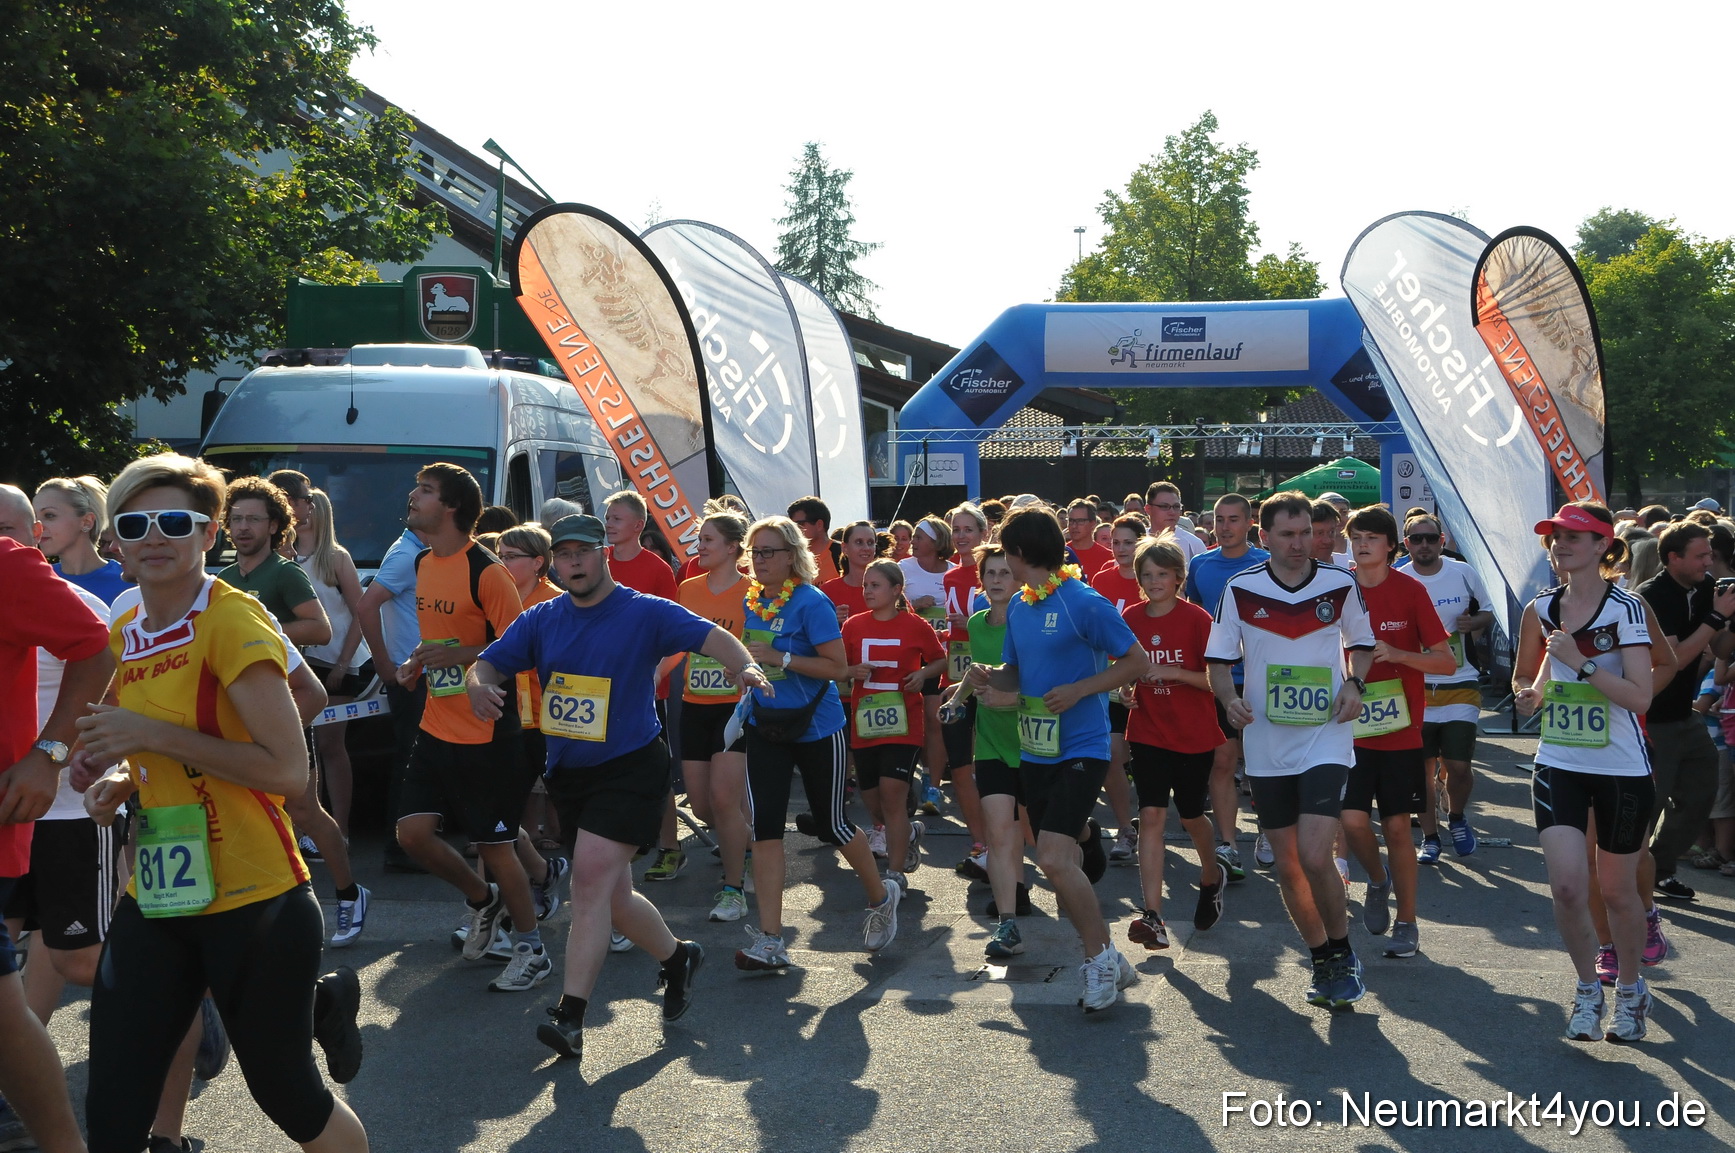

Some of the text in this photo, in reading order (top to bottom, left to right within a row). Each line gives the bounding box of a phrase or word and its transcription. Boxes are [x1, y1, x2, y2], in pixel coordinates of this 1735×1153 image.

[436, 326, 460, 336] 1628
[1171, 325, 1203, 333] Fischer
[1146, 342, 1243, 360] firmenlauf
[960, 377, 1012, 388] Fischer
[1349, 374, 1363, 383] und
[434, 599, 454, 614] KU
[151, 652, 189, 679] BÖGL
[862, 638, 900, 690] E
[1270, 685, 1329, 711] 1306
[549, 695, 595, 724] 623
[863, 708, 898, 727] 168
[1545, 703, 1605, 732] 1316
[1019, 714, 1056, 741] 1177
[140, 845, 196, 890] 812
